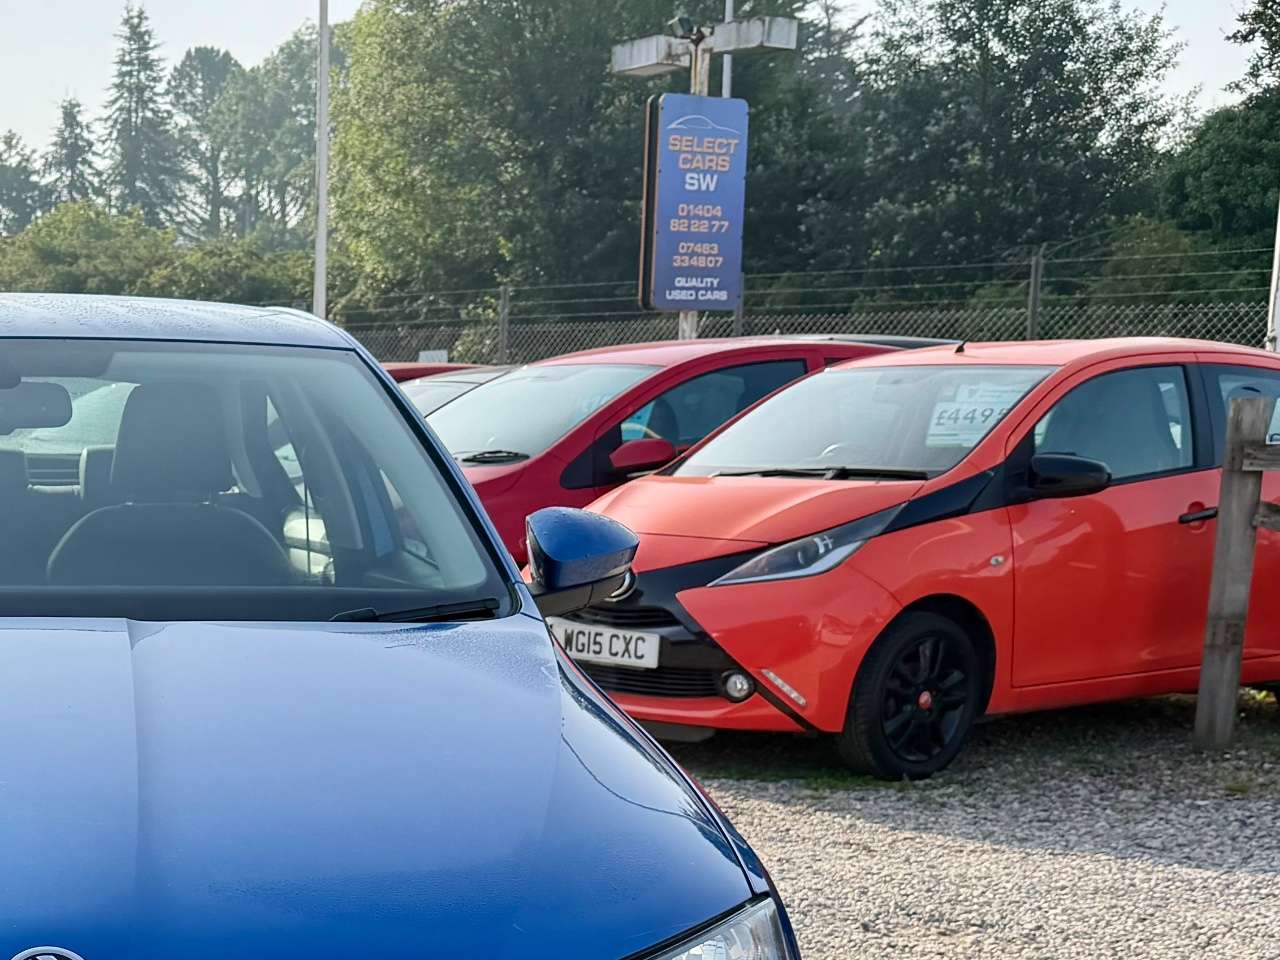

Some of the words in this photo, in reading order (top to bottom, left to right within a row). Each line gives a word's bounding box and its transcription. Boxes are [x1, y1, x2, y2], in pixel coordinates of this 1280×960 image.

[668, 135, 740, 154] SELECT
[678, 153, 731, 172] CARS
[684, 173, 719, 192] SW
[678, 203, 722, 218] 01404
[674, 276, 720, 289] QUALITY
[666, 289, 697, 301] USED
[697, 290, 728, 301] CARS
[564, 628, 604, 655] WG15
[608, 634, 646, 660] CXC
